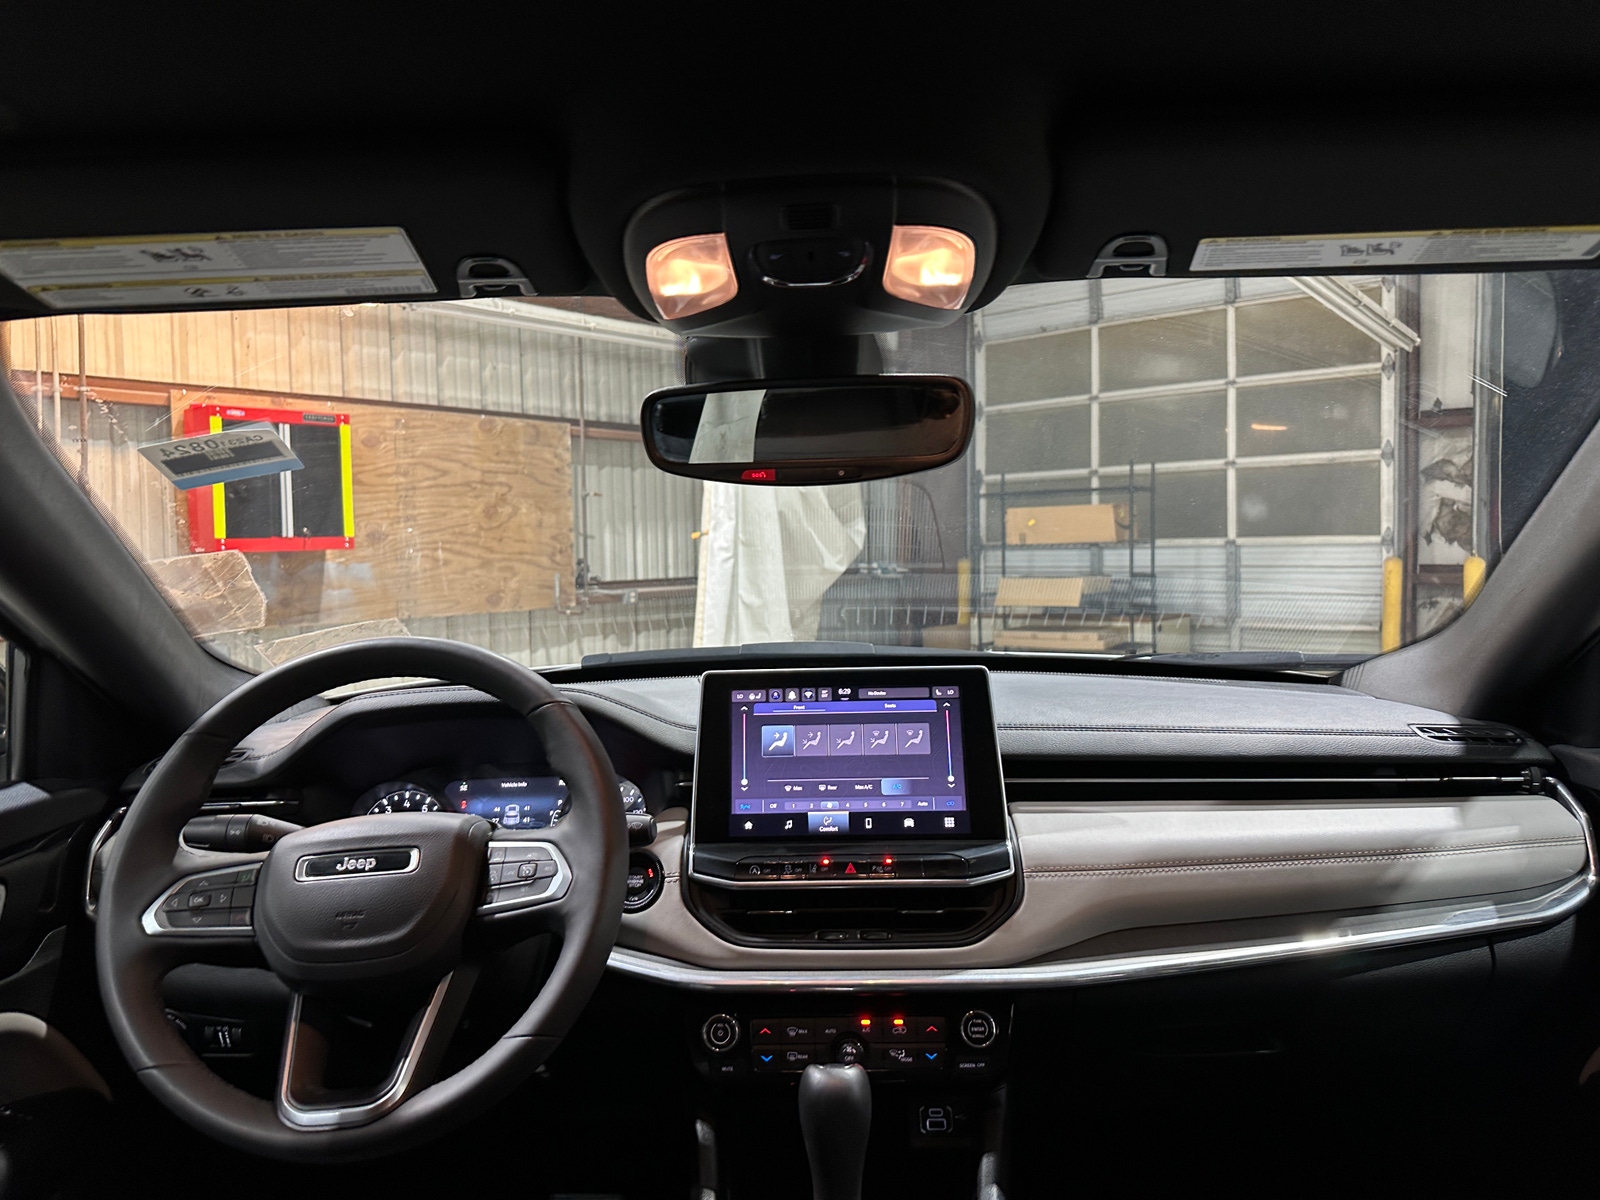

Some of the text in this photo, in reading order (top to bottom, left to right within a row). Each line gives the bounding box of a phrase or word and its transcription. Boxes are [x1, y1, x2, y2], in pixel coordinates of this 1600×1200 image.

[386, 800, 428, 814] 3 4 5
[336, 857, 377, 872] Jeep
